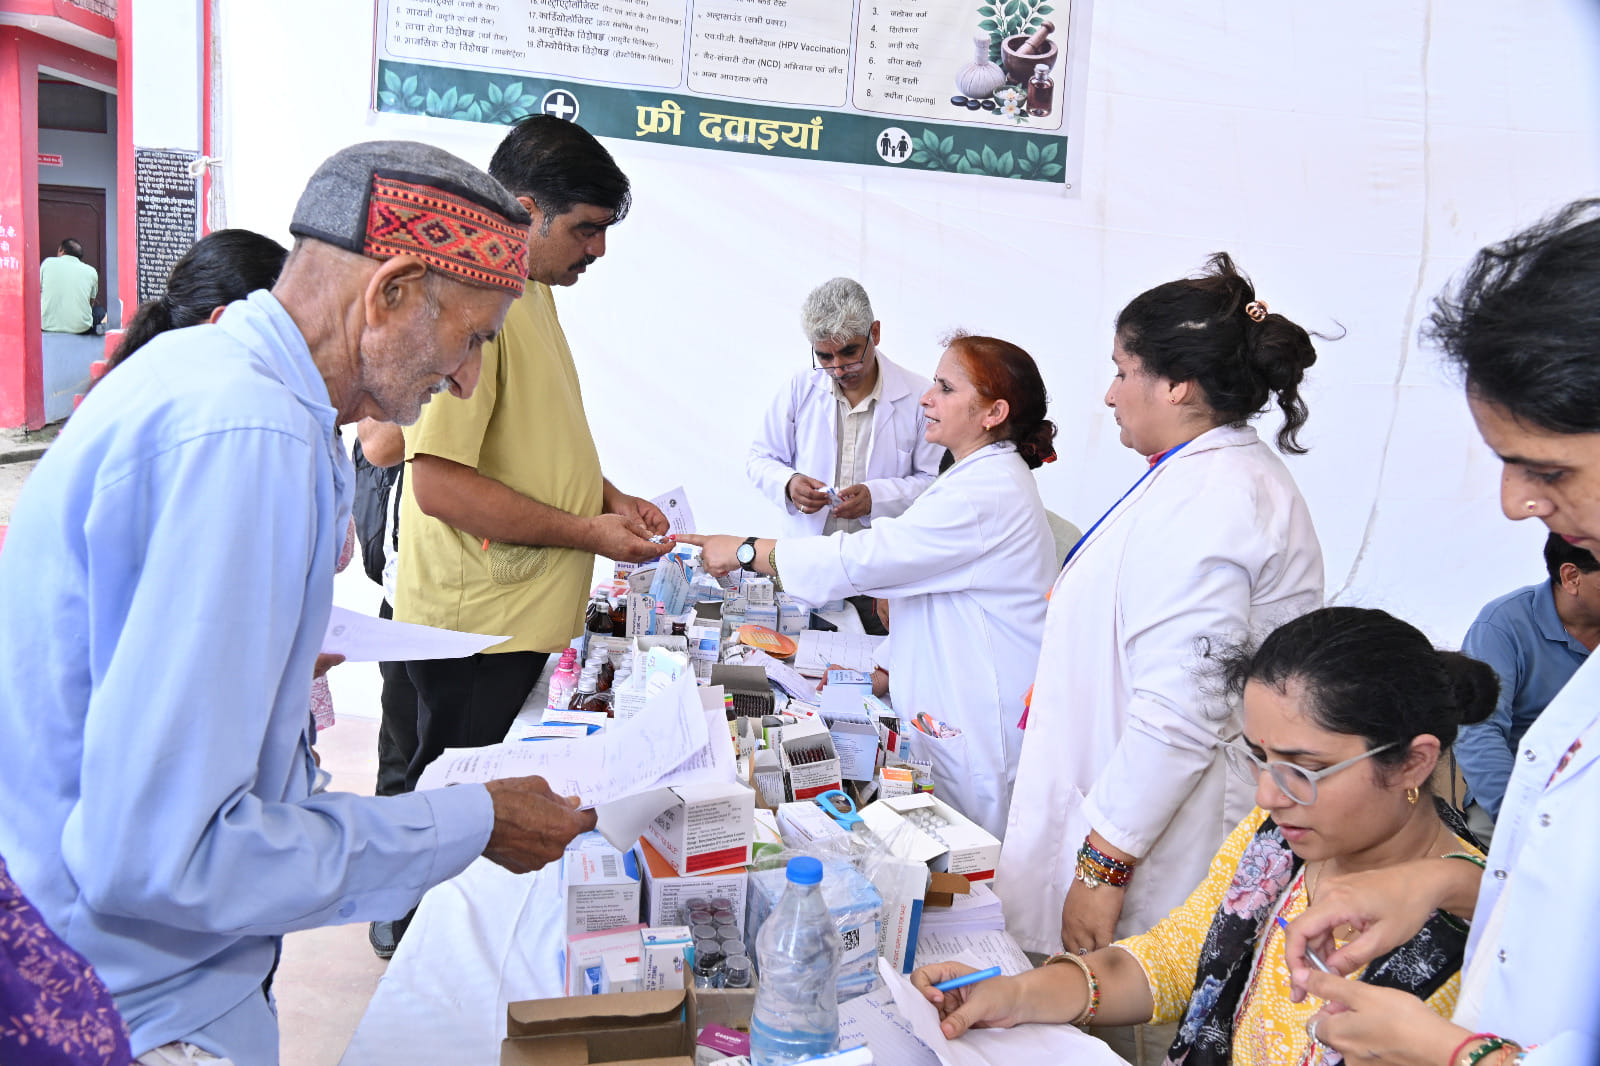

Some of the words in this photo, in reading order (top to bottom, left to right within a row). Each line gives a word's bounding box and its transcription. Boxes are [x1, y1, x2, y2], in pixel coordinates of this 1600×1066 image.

[872, 7, 879, 16] 3.
[871, 24, 878, 33] 4.
[778, 40, 798, 50] (HPV
[801, 42, 849, 56] Vaccination)
[870, 41, 877, 49] 5.
[758, 59, 781, 70] (NCD)
[868, 56, 876, 65] 6.
[868, 72, 875, 80] 7.
[866, 88, 873, 98] 8.
[906, 94, 936, 106] (Cupping)
[636, 100, 686, 136] फ्री
[699, 112, 824, 150] दवाइयाँ
